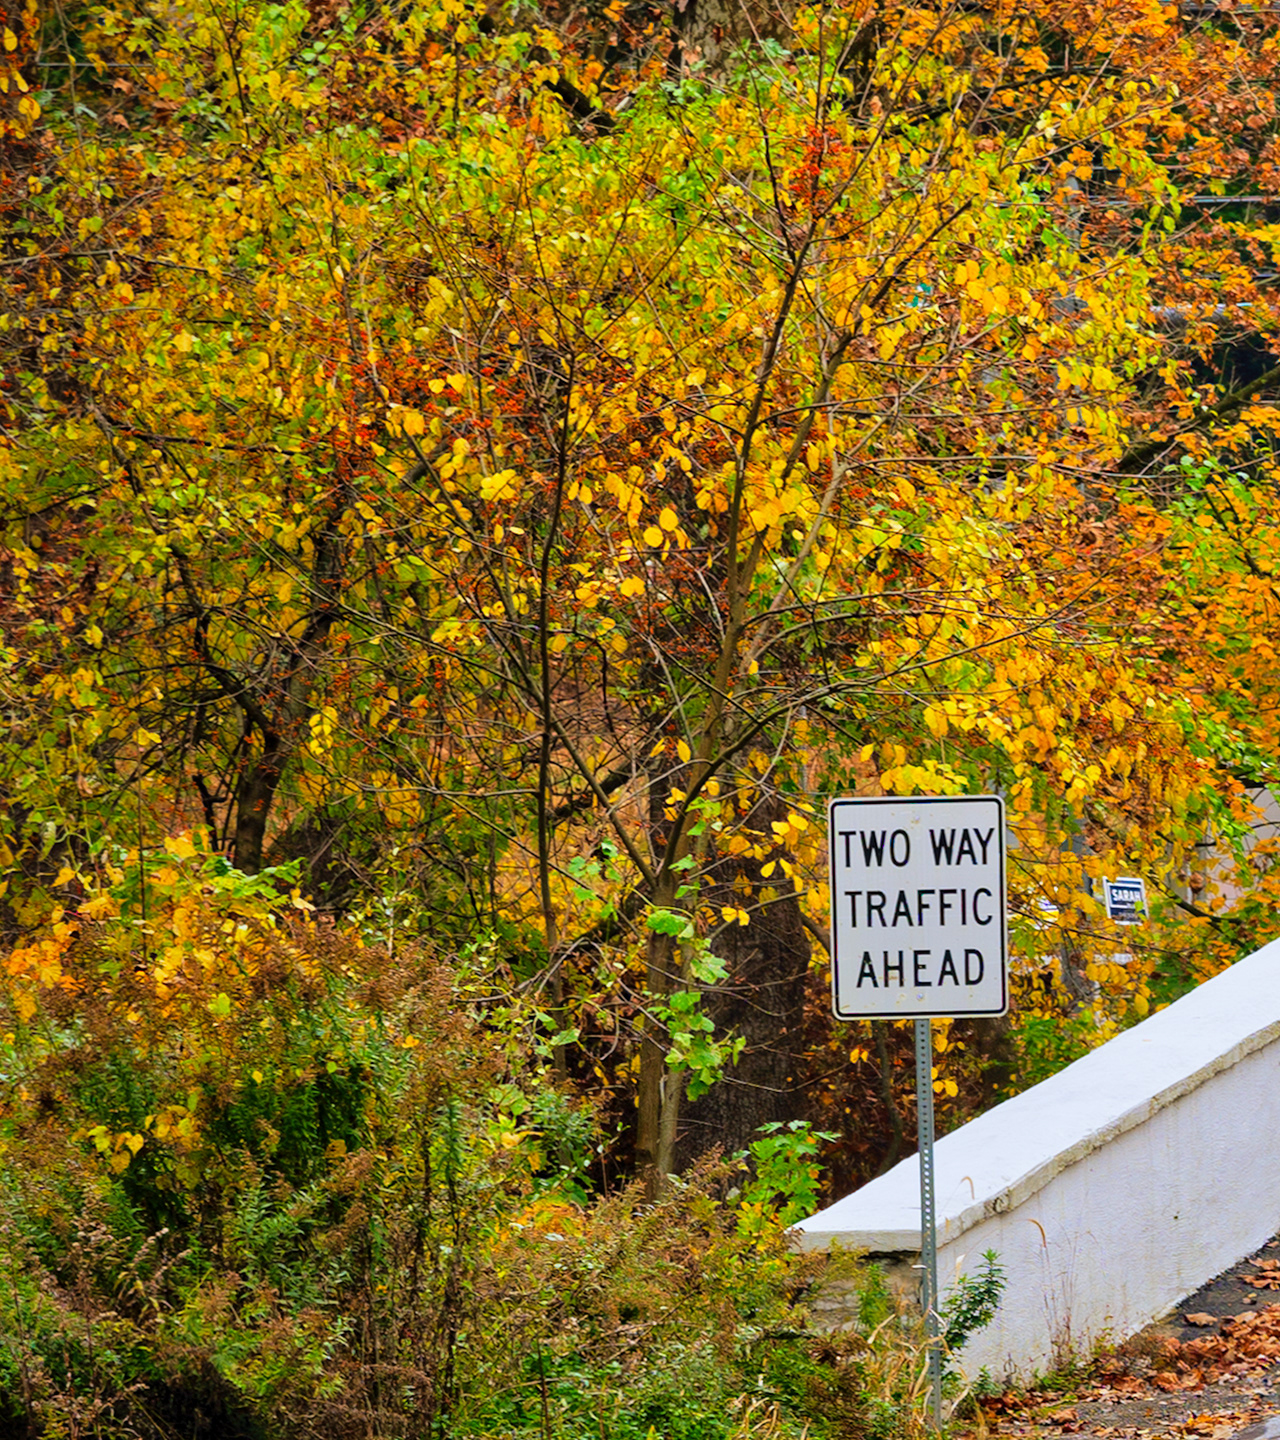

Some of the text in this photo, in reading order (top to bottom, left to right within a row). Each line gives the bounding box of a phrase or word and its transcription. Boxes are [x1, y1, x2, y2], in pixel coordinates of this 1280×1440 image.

[838, 828, 995, 868] TWO WAY
[844, 888, 993, 928] TRAFFIC
[856, 948, 985, 988] AHEAD
